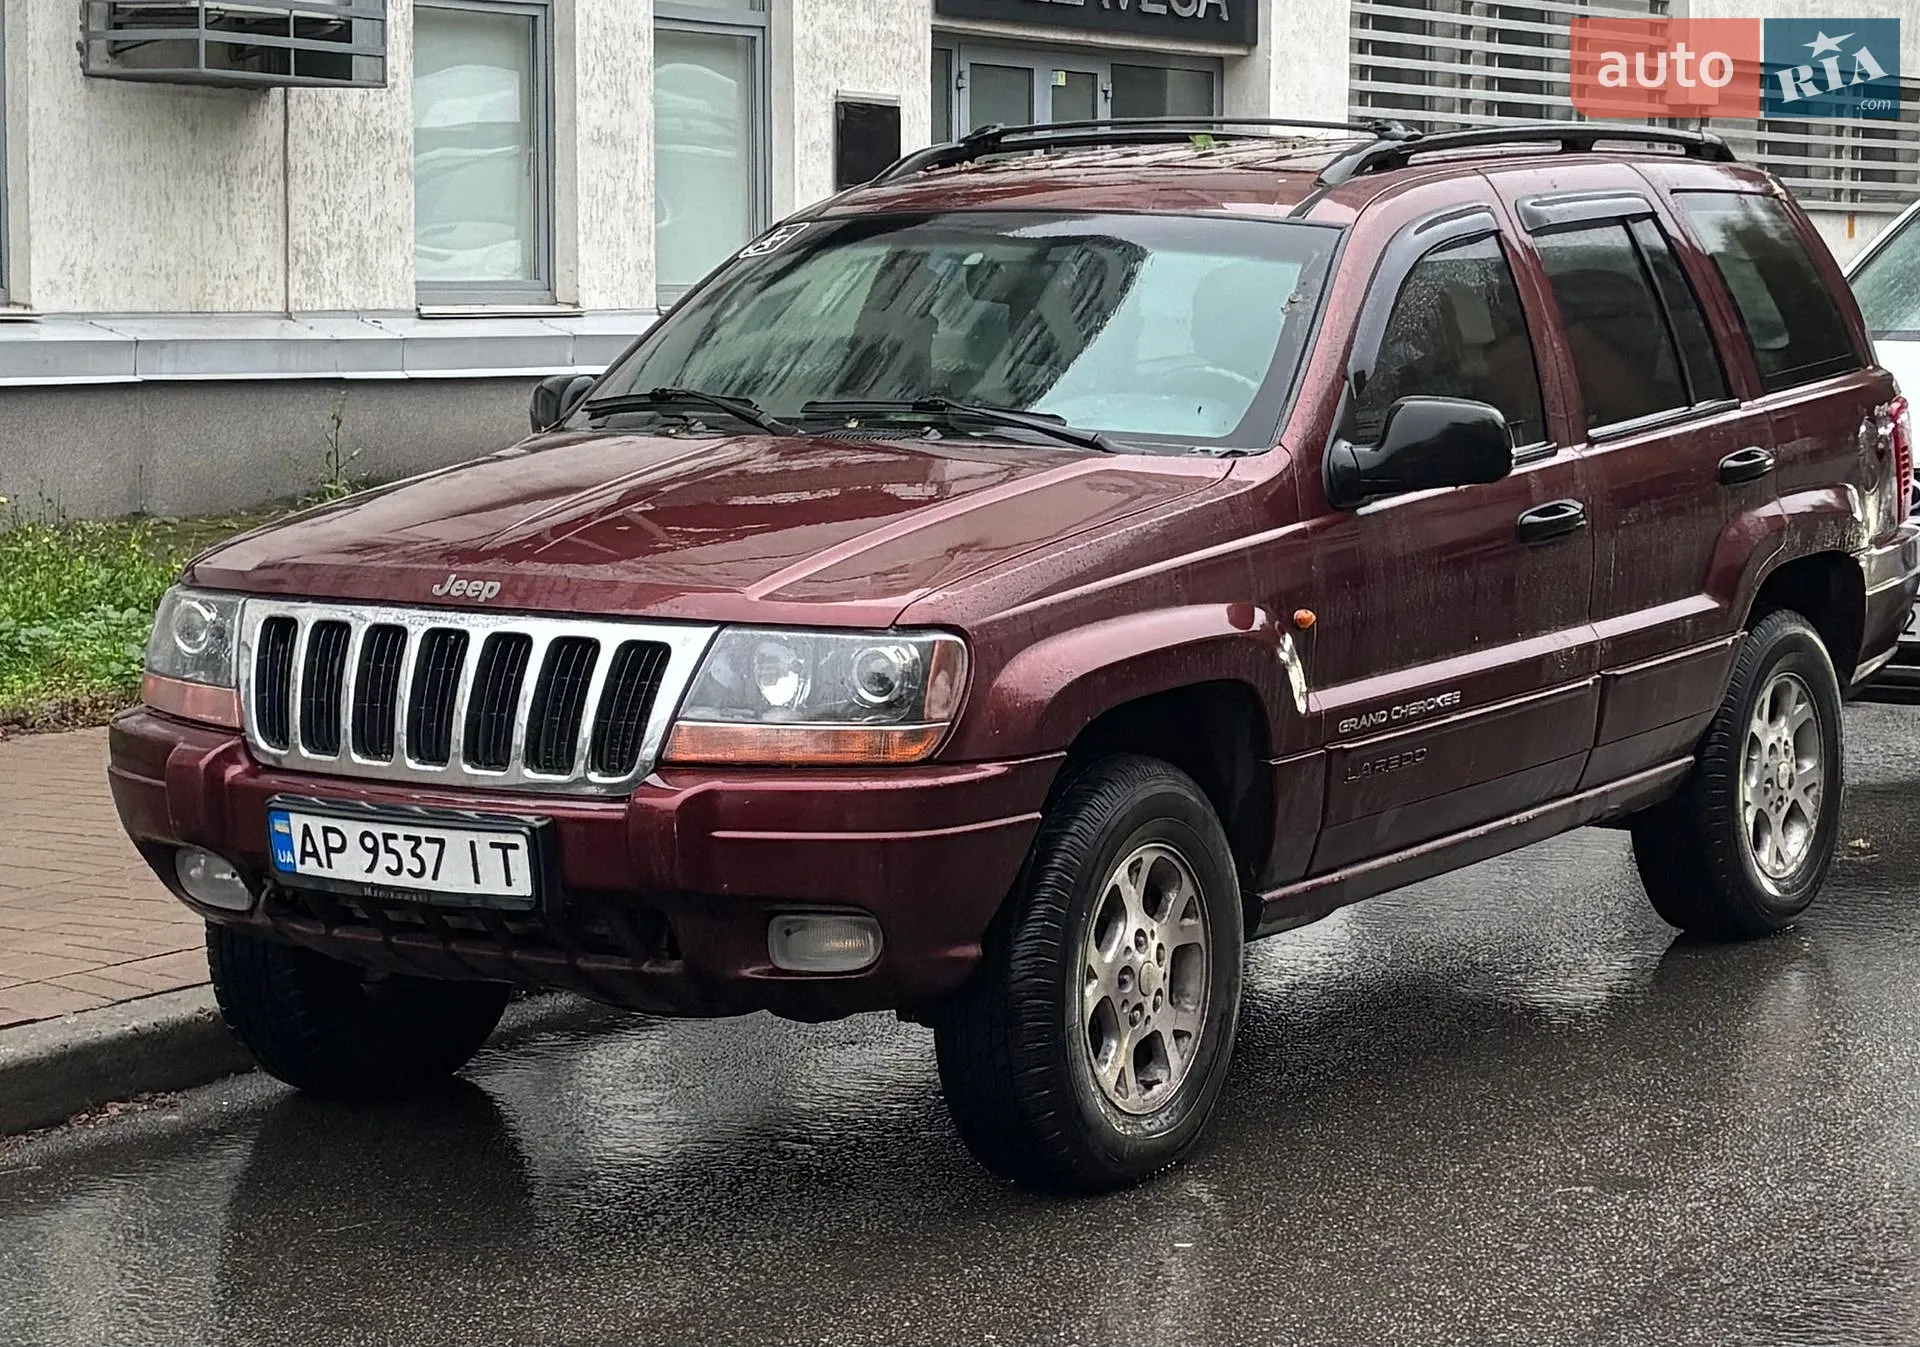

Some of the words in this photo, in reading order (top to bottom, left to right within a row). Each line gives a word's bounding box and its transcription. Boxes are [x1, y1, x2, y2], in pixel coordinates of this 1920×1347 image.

[432, 574, 501, 602] Jeep
[1338, 710, 1388, 733] GRAND
[1391, 691, 1461, 719] CHEROKEE
[1344, 748, 1427, 784] LAREDO
[278, 849, 295, 864] UA
[299, 823, 347, 869] AP
[359, 830, 446, 881] 9537
[469, 840, 520, 887] IT
